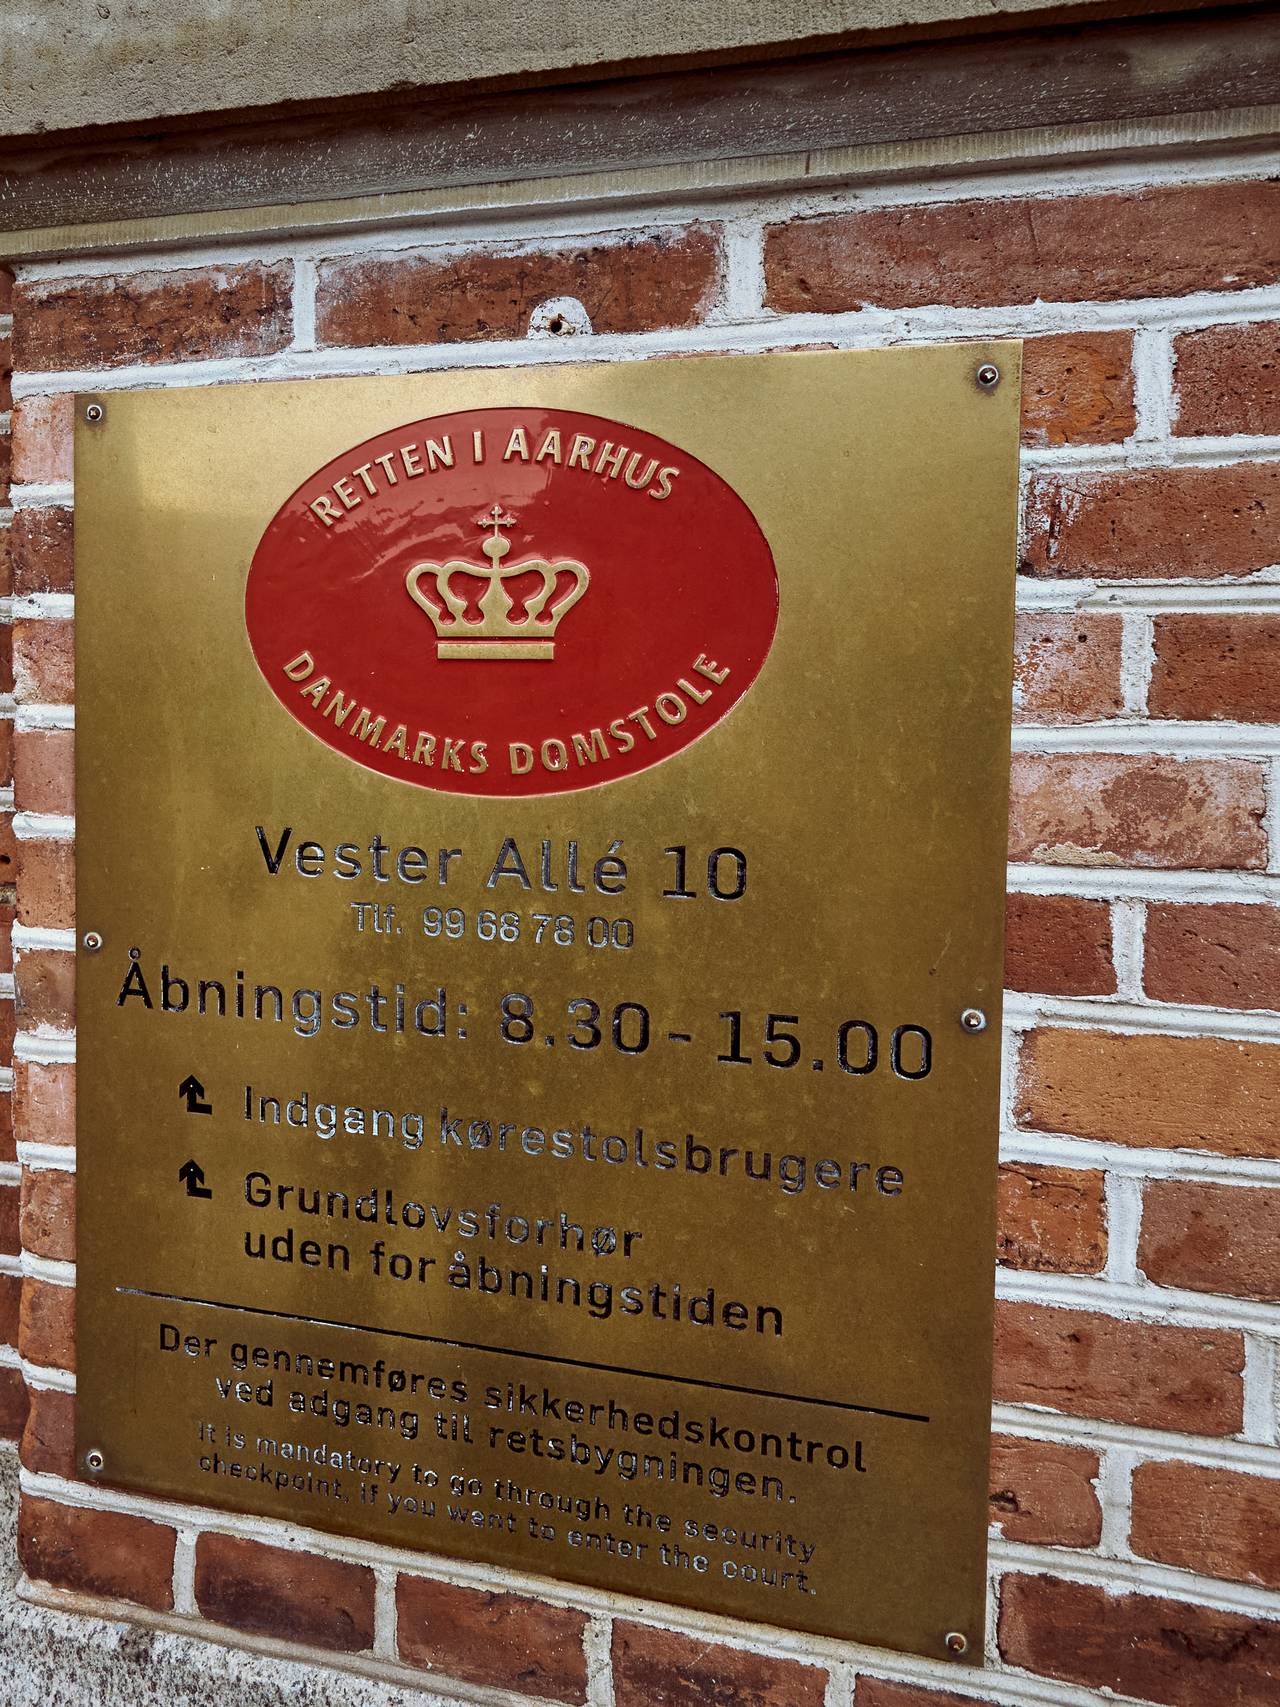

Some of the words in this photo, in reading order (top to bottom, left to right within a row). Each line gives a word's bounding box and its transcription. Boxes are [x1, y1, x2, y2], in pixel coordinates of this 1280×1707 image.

[309, 433, 454, 527] RETTEN
[472, 430, 483, 463] I
[503, 427, 681, 501] AARHUS
[283, 650, 489, 775] DANMARKS
[508, 653, 731, 775] DOMSTOLE
[255, 825, 463, 885] Vester
[486, 837, 629, 896] Allé
[662, 844, 748, 901] 10
[350, 902, 403, 934] Tlf.
[423, 905, 465, 939] 99
[476, 909, 520, 943] 68
[531, 912, 575, 946] 78
[586, 916, 634, 950] 00
[116, 946, 470, 1040] Åbningstid:
[499, 992, 651, 1056] 8.30
[668, 1031, 693, 1043] -
[716, 1010, 933, 1081] 15.00
[243, 1085, 425, 1150] Indgang
[438, 1105, 906, 1197] kørestolsbrugere
[244, 1169, 643, 1259] Grundlovsforhør
[244, 1227, 351, 1272] uden
[370, 1239, 437, 1283] for
[448, 1250, 784, 1337] åbningstiden
[159, 1323, 217, 1358] Der
[230, 1341, 469, 1403] gennemføres
[485, 1382, 867, 1473] sikkerhedskontrol
[216, 1376, 273, 1408] ved
[288, 1389, 419, 1440] adgang
[434, 1411, 473, 1444] til
[488, 1424, 797, 1504] retsbygningen.
[197, 1421, 217, 1445] It
[225, 1424, 247, 1449] is
[256, 1436, 403, 1484] mandatory
[411, 1463, 439, 1488] to
[449, 1473, 483, 1497] go
[494, 1478, 611, 1522] through
[622, 1503, 672, 1533] the
[683, 1517, 817, 1565] security
[386, 1491, 437, 1518] you
[446, 1501, 518, 1535] want
[527, 1516, 557, 1542] to
[566, 1528, 649, 1560] enter
[658, 1542, 709, 1573] the
[722, 1559, 817, 1596] court.
